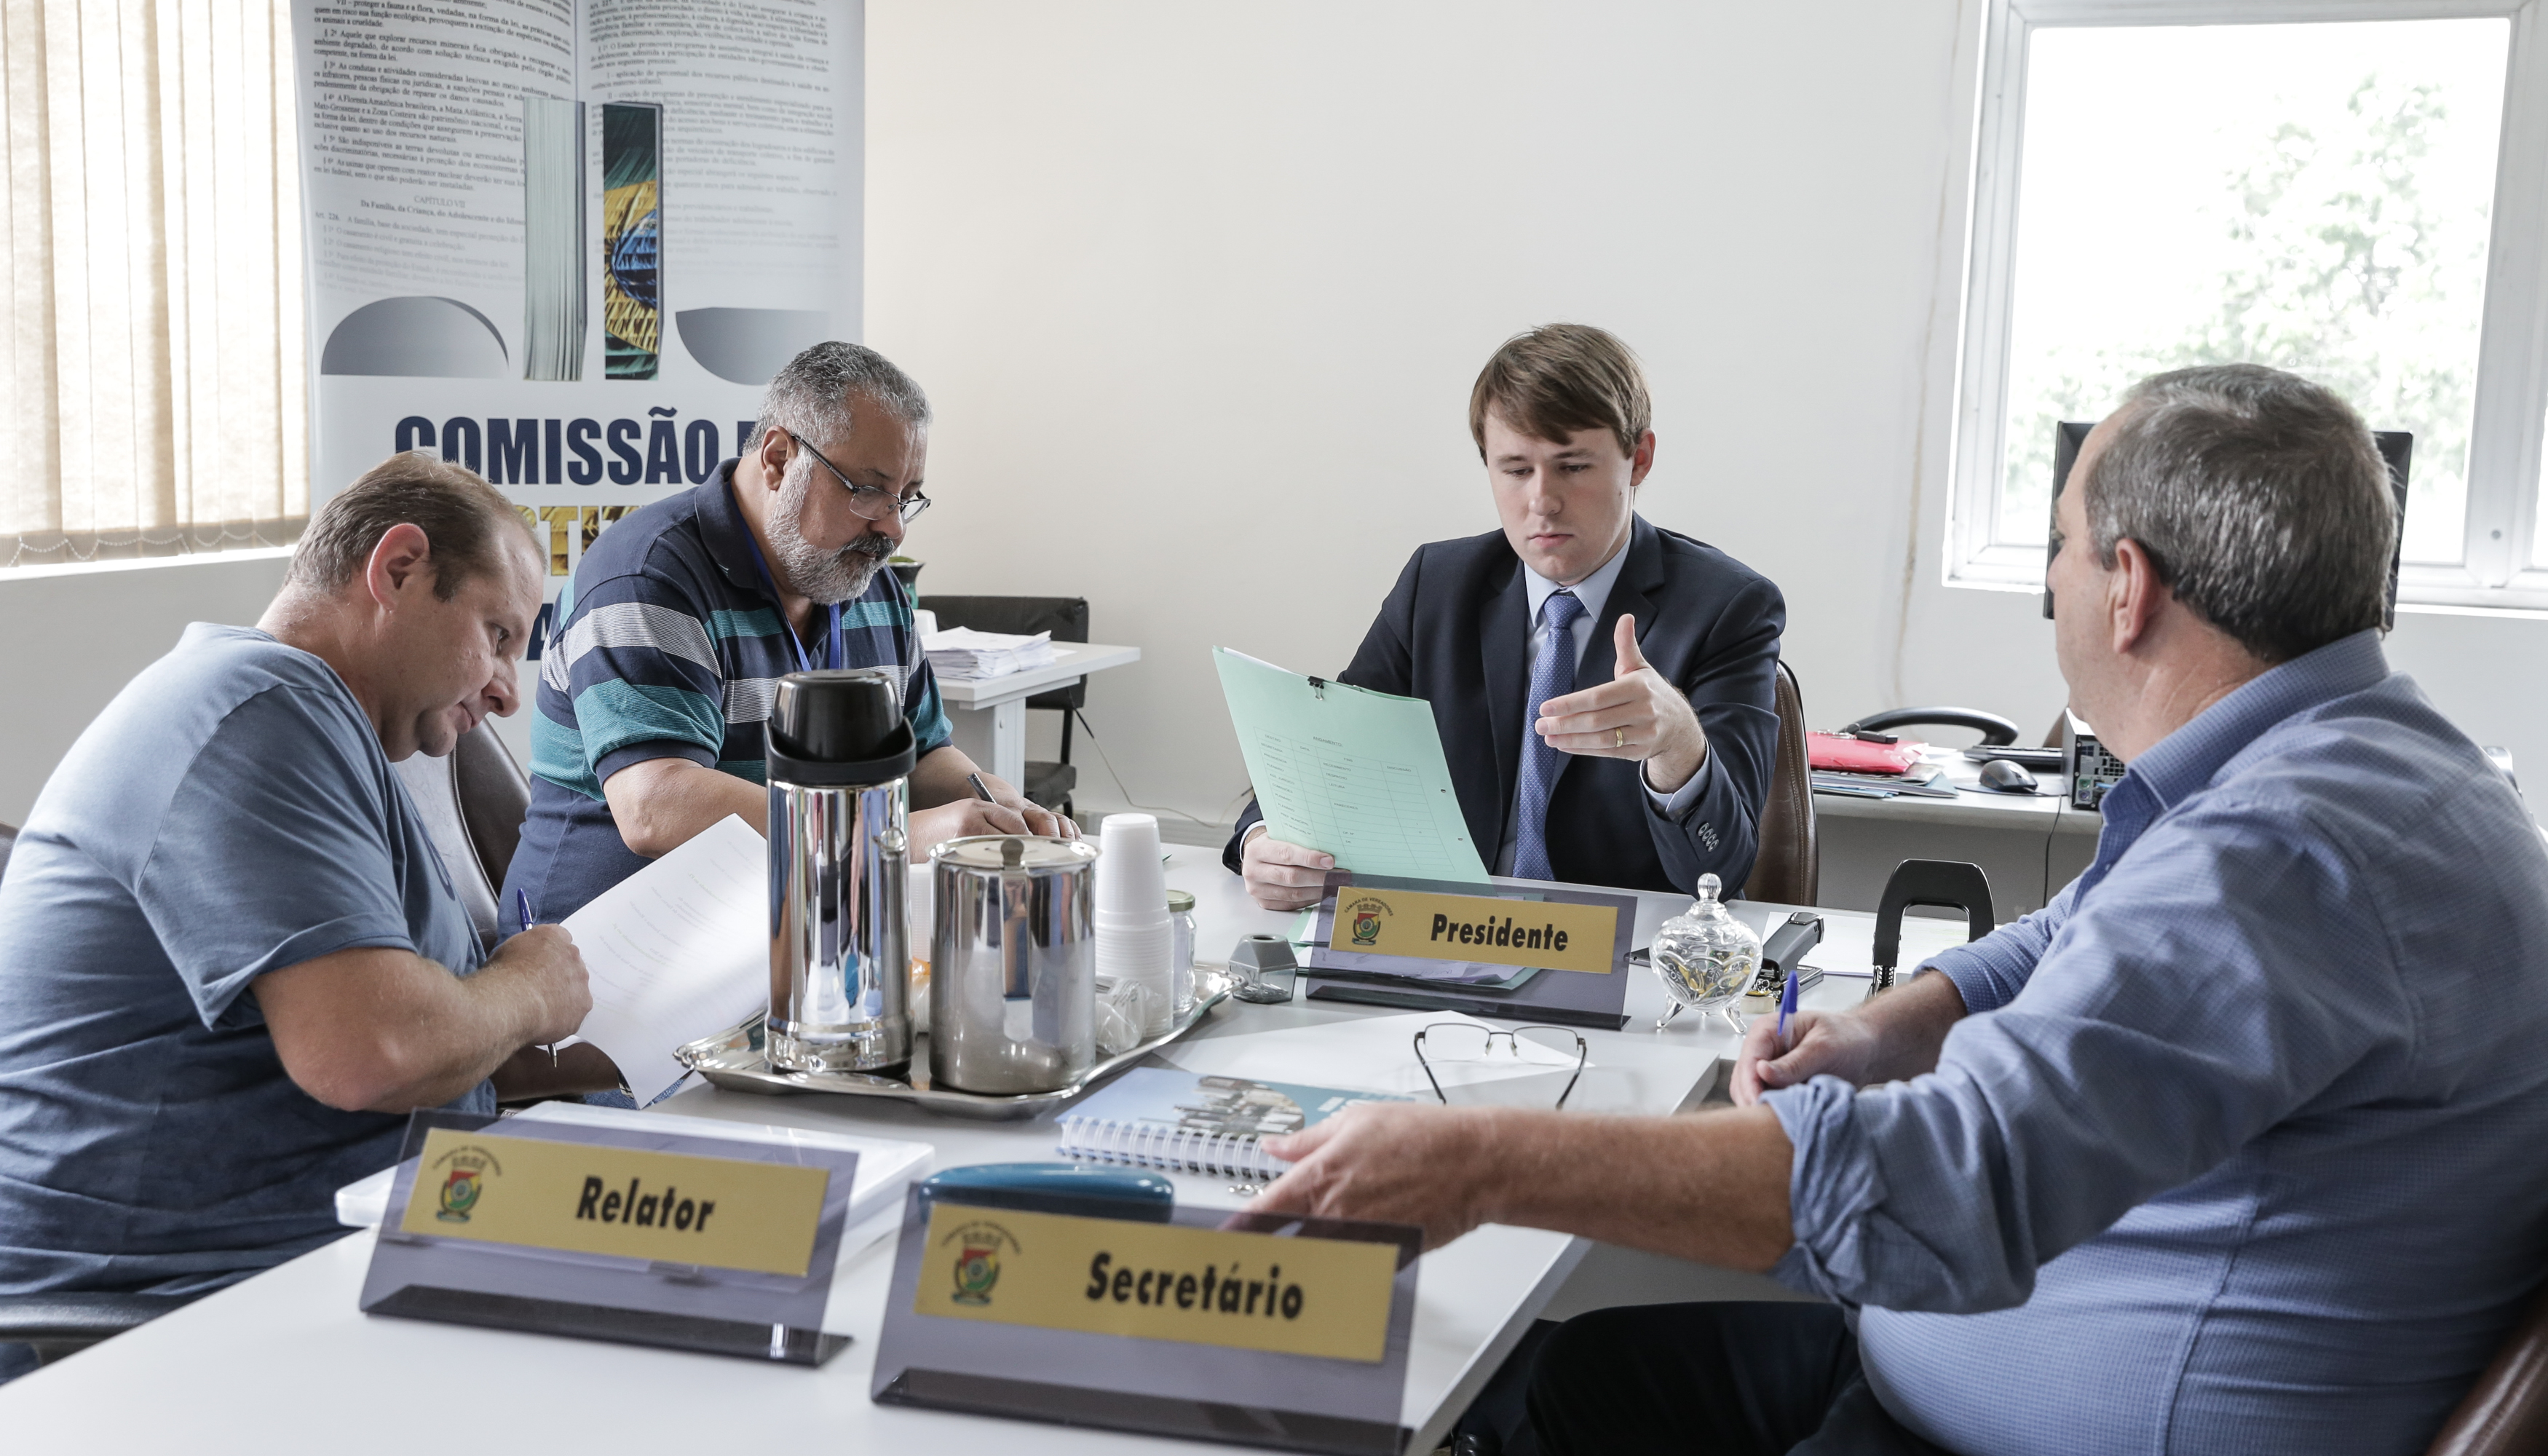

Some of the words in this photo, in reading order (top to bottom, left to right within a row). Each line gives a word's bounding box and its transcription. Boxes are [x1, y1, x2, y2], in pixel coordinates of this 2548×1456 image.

[314, 49, 349, 58] competente,
[360, 51, 378, 60] forma
[341, 30, 362, 39] Aquele
[365, 33, 376, 41] que
[379, 33, 406, 43] explorar
[409, 36, 437, 45] recursos
[440, 41, 470, 50] minerais
[473, 44, 486, 52] fica
[490, 47, 520, 59] obrigado
[344, 40, 378, 51] degradado,
[392, 45, 414, 53] acordo
[435, 50, 462, 59] solução
[465, 54, 490, 63] técnica
[494, 58, 518, 68] exigida
[521, 63, 536, 73] pelo
[339, 62, 347, 70] As
[349, 64, 376, 72] condutas
[384, 66, 416, 76] atividades
[419, 71, 464, 82] consideradas
[466, 76, 489, 86] lesivas
[502, 82, 519, 91] meio
[314, 101, 360, 113] Mato-Grossense
[372, 108, 388, 116] Zona
[389, 109, 416, 119] Costeira
[431, 115, 470, 124] patrimônio
[471, 120, 502, 130] nacional,
[360, 199, 370, 207] Da
[371, 201, 396, 212] Família,
[407, 205, 436, 217] Criança,
[448, 211, 488, 222] Adolescente
[414, 194, 452, 207] CAPÍTULO
[1344, 899, 1361, 913] CÂMARA
[1369, 897, 1393, 917] VEREADORES
[1431, 914, 1568, 951] Presidente
[576, 1176, 714, 1232] Relator
[1085, 1251, 1304, 1320] Secretário
